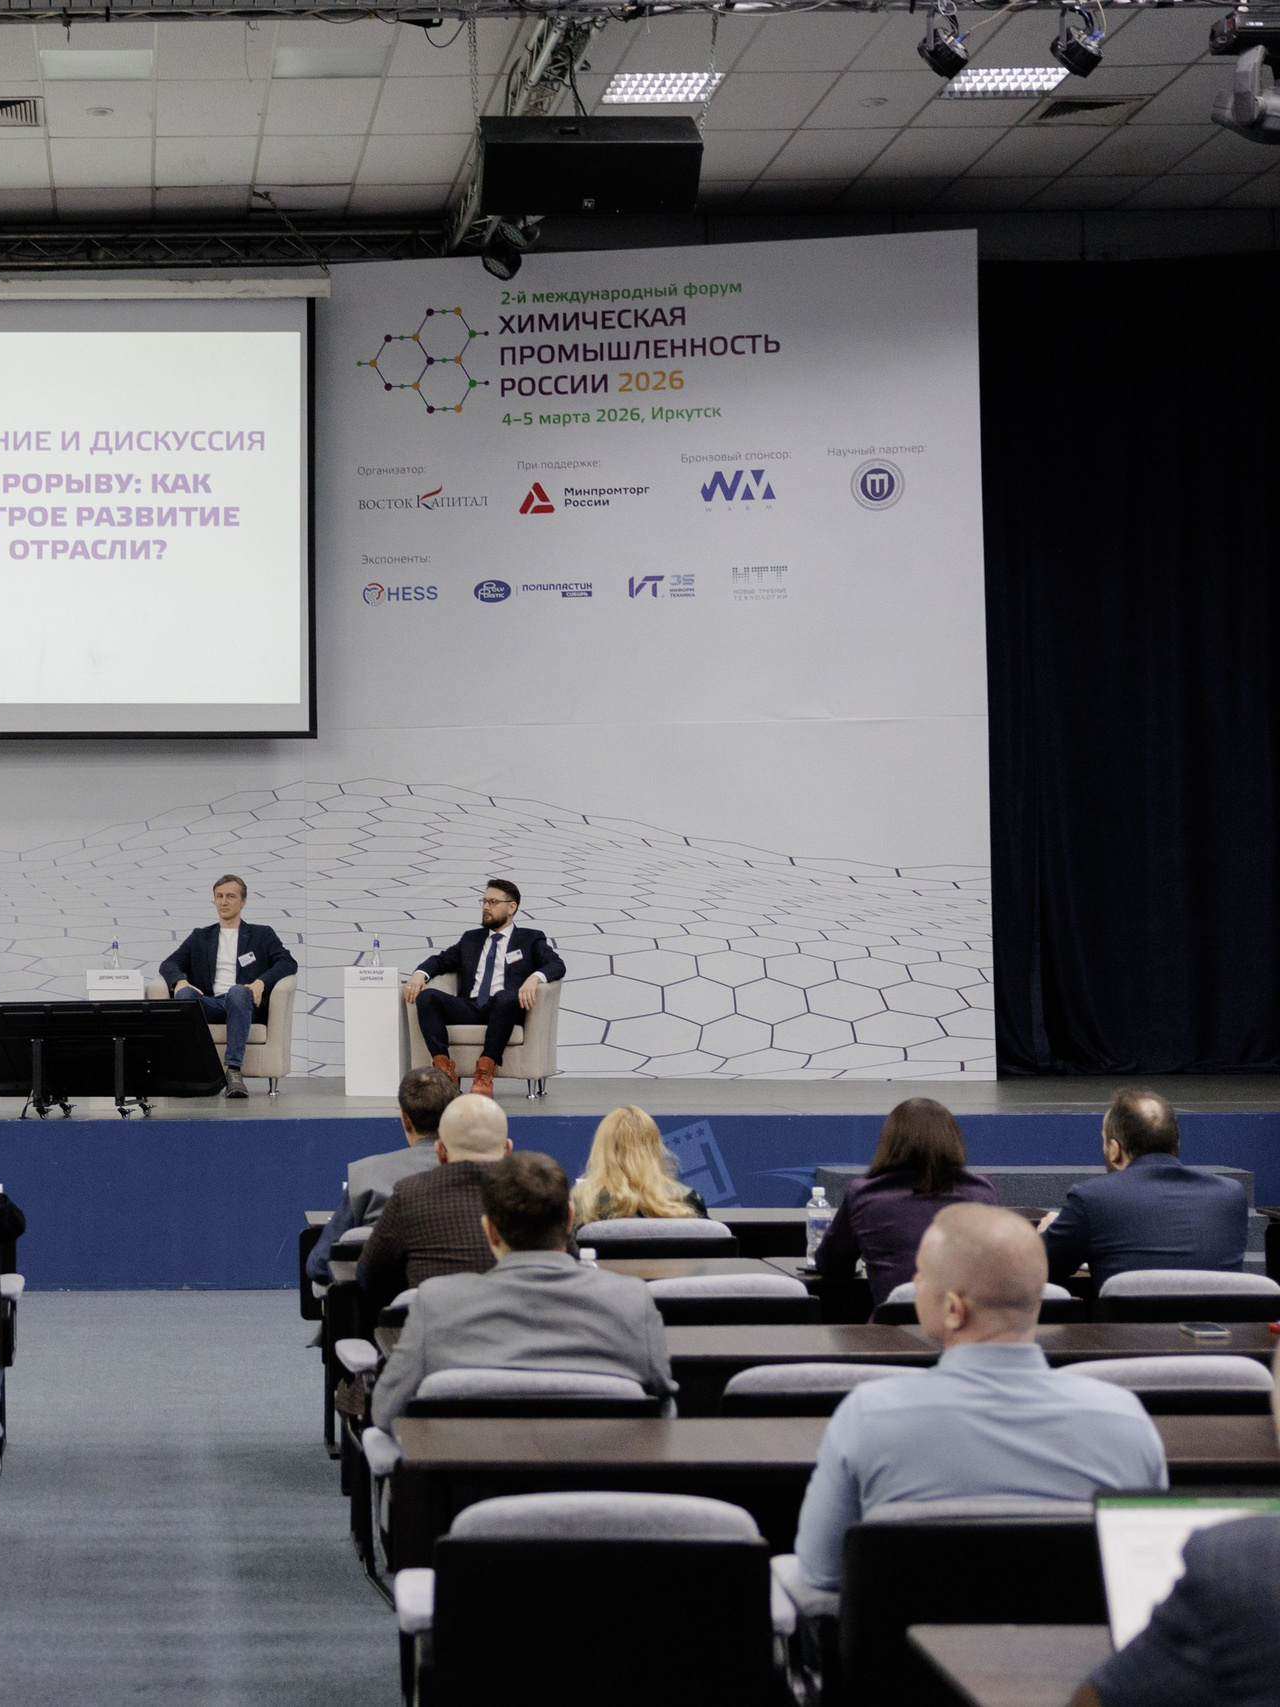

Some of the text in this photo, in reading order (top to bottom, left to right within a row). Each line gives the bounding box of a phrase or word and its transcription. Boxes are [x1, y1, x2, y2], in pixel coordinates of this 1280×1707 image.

[501, 281, 742, 305] 2-й международный форум
[499, 306, 686, 335] ХИМИЧЕСКАЯ
[500, 334, 781, 366] ПРОМЫШЛЕННОСТЬ
[500, 370, 685, 397] РОССИИ 2026
[539, 411, 591, 428] марта
[595, 407, 645, 426] 2026,
[651, 405, 721, 423] Иркутск
[62, 430, 80, 451] И
[90, 430, 265, 454] ДИСКУССИЯ
[827, 445, 927, 457] Научный партнер:
[517, 460, 601, 471] При поддержке:
[681, 451, 792, 464] Бронзовый спонсор:
[357, 466, 427, 476] Организатор:
[151, 473, 212, 494] КАК
[564, 486, 650, 497] Минпромторг
[359, 498, 413, 510] ВОСТОК
[564, 498, 610, 507] России
[76, 506, 240, 527] РАЗВИТИЕ
[8, 539, 167, 560] ОТРАСЛИ?
[361, 555, 431, 565] Экспоненты:
[387, 586, 438, 601] HESS
